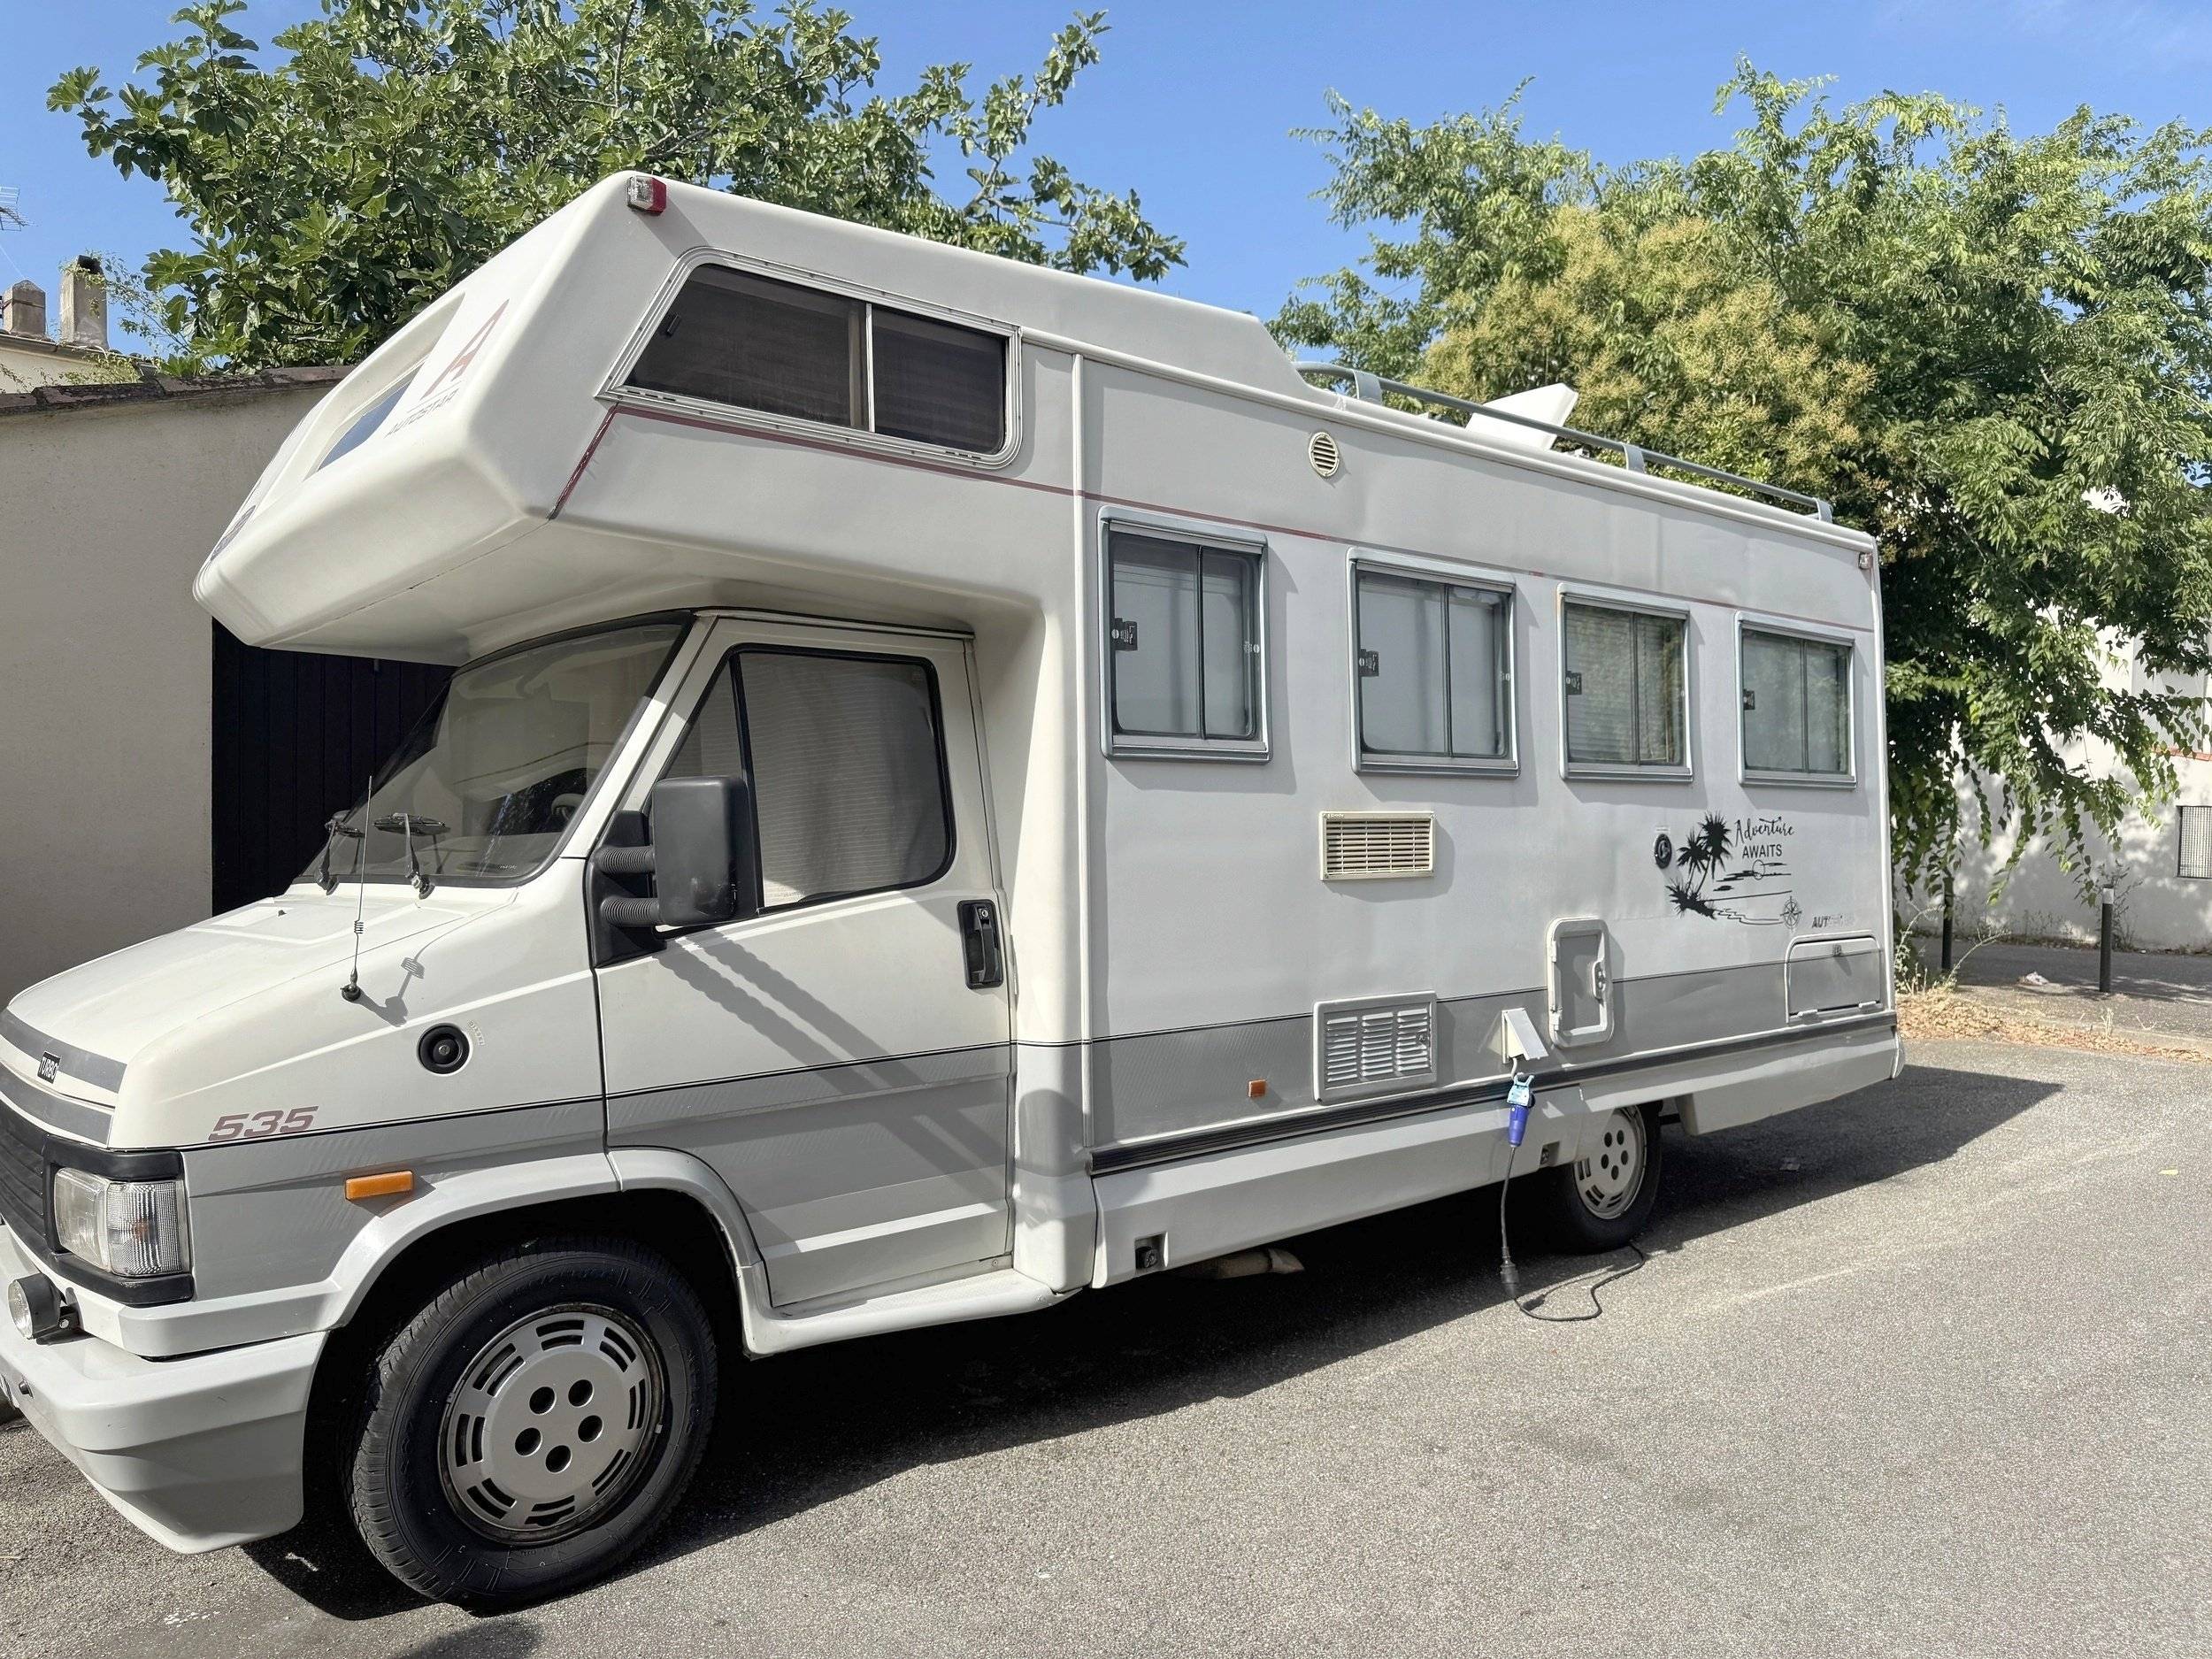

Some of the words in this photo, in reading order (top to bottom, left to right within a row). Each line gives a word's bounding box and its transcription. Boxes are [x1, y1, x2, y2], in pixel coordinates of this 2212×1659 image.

[1734, 816, 1794, 848] Adventure
[1742, 843, 1783, 859] AWAITS
[38, 1056, 59, 1080] TURBO
[208, 1105, 319, 1141] 535
